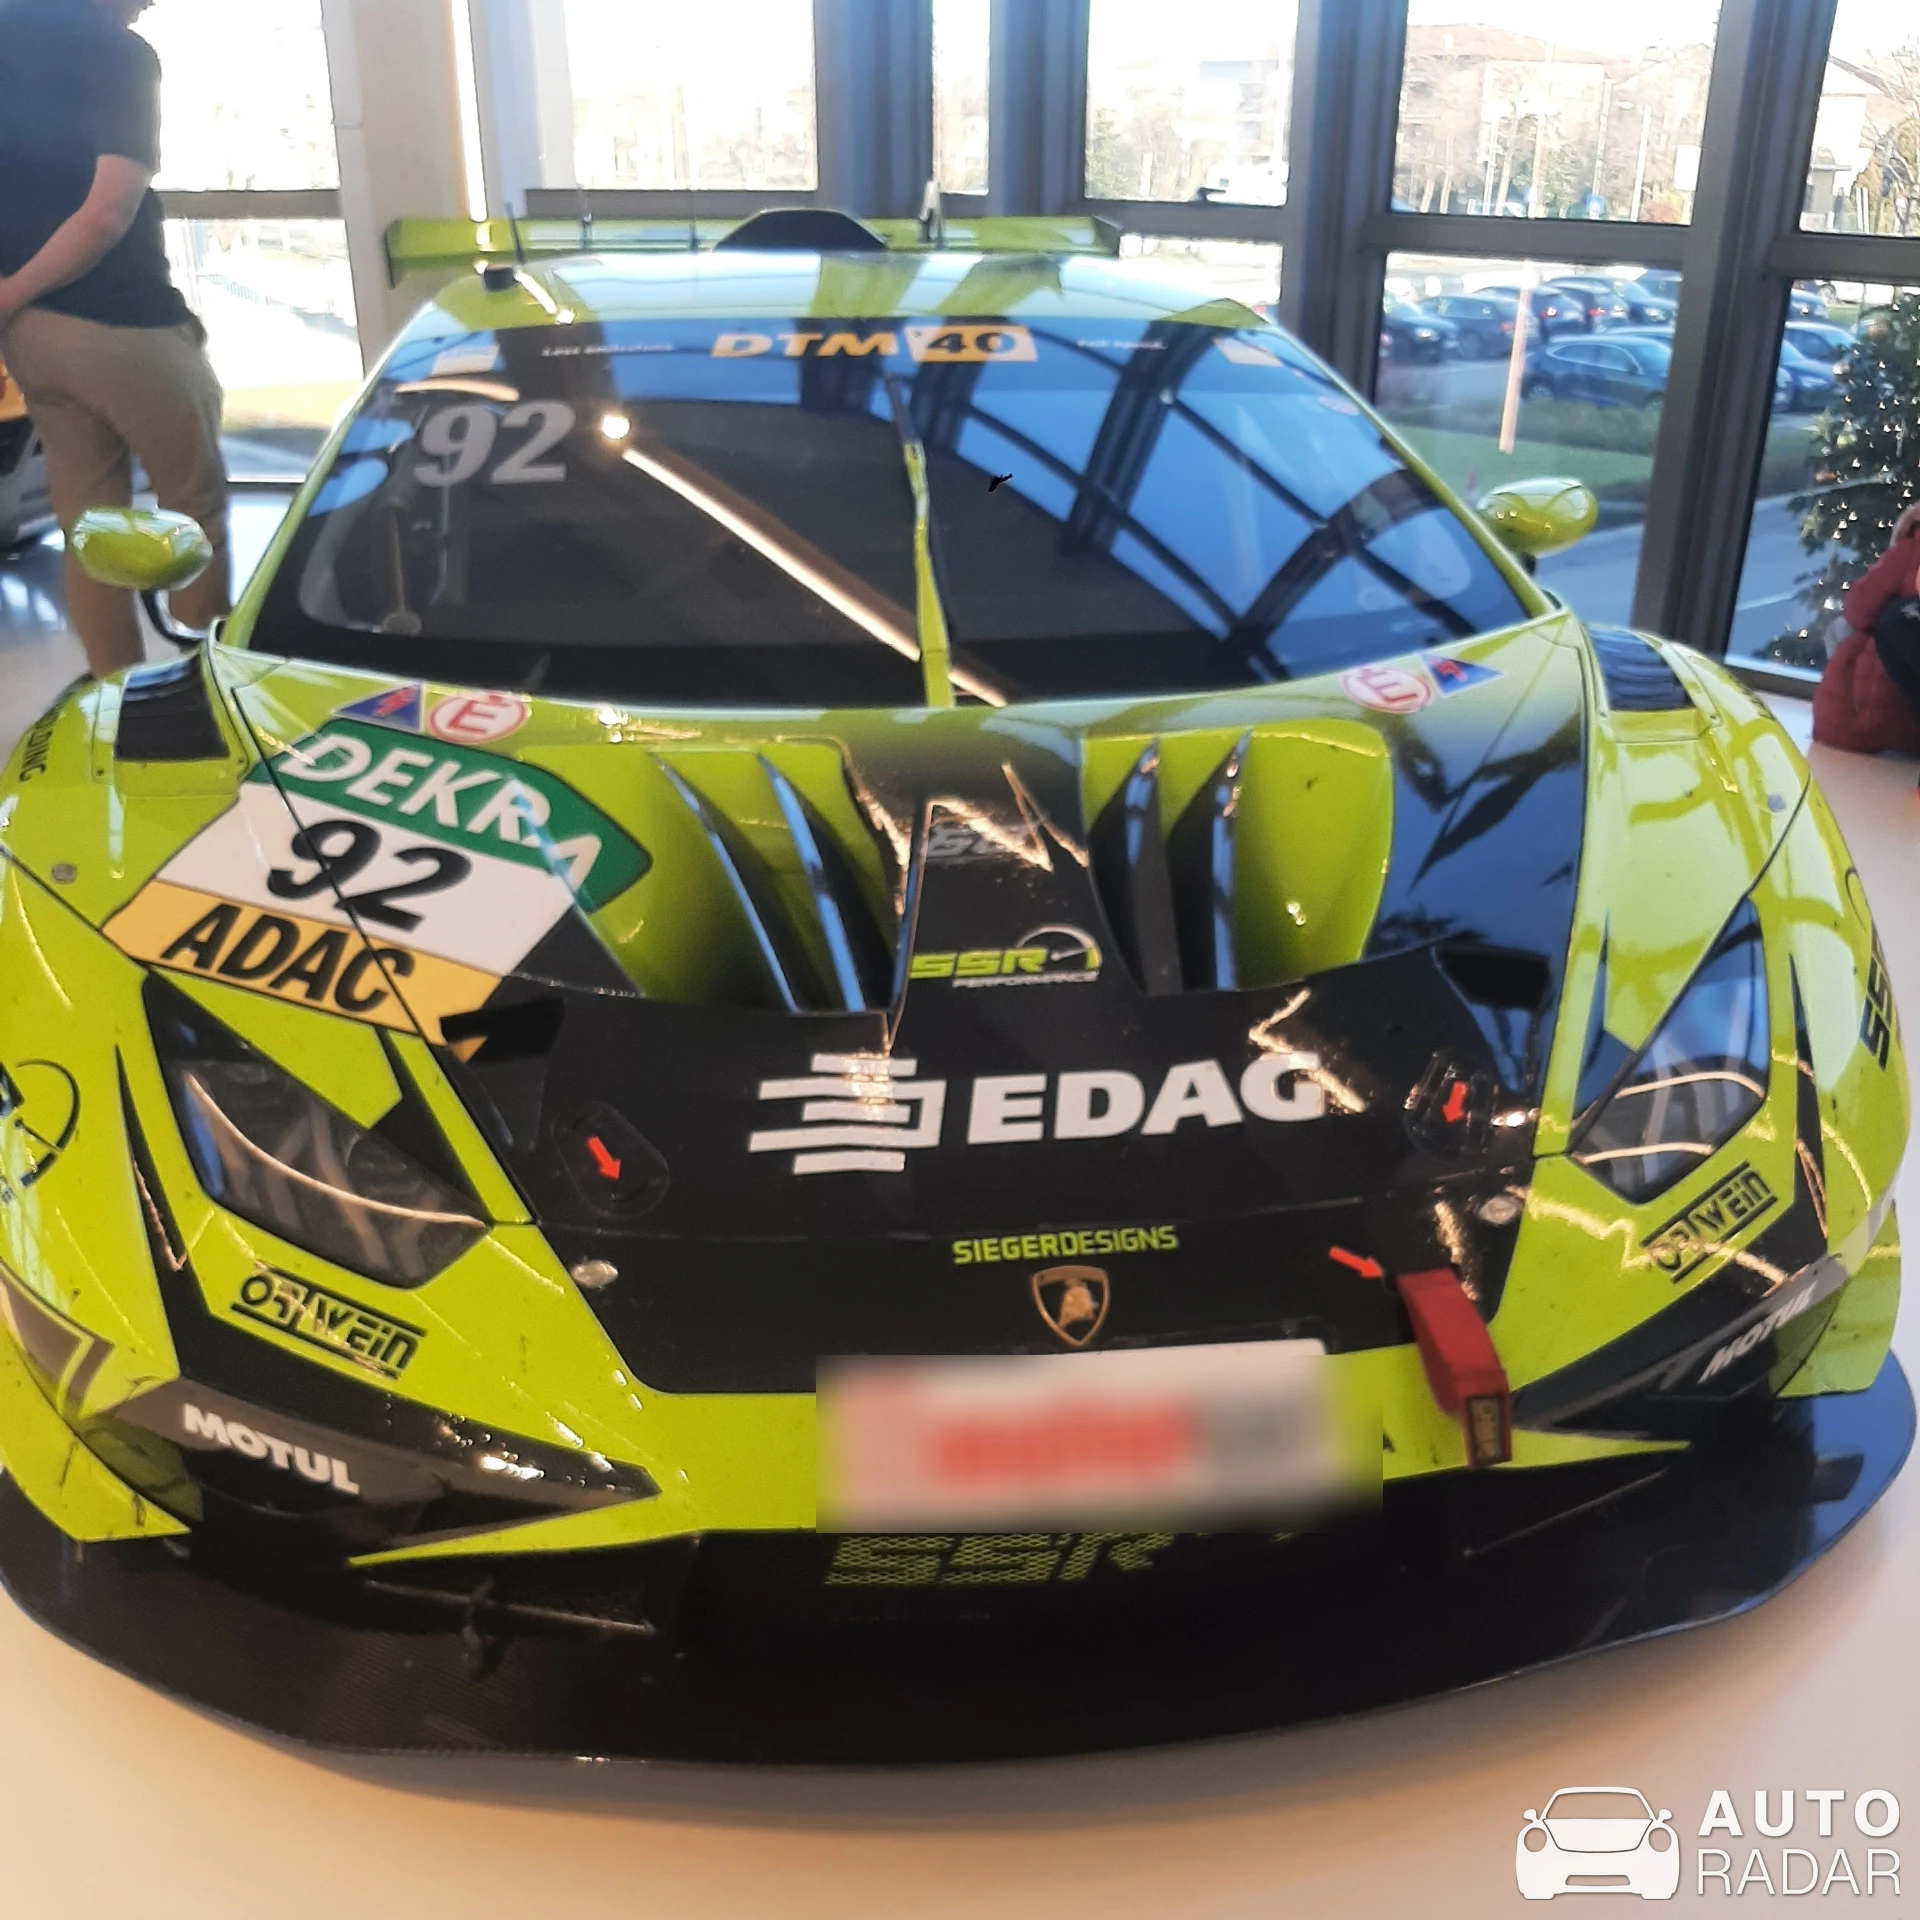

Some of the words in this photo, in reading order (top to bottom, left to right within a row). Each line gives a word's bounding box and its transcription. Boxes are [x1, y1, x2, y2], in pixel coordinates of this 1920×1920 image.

[710, 332, 898, 358] DTM
[926, 331, 1017, 355] 40
[412, 400, 577, 488] 92
[278, 732, 602, 892] DEKRA
[266, 818, 473, 934] 92
[159, 902, 416, 1013] ADAC
[909, 947, 1048, 980] SSR
[966, 1051, 1326, 1146] EDAG
[951, 1225, 1181, 1266] SIEGERDESIGNS
[183, 1402, 360, 1496] MOTUL
